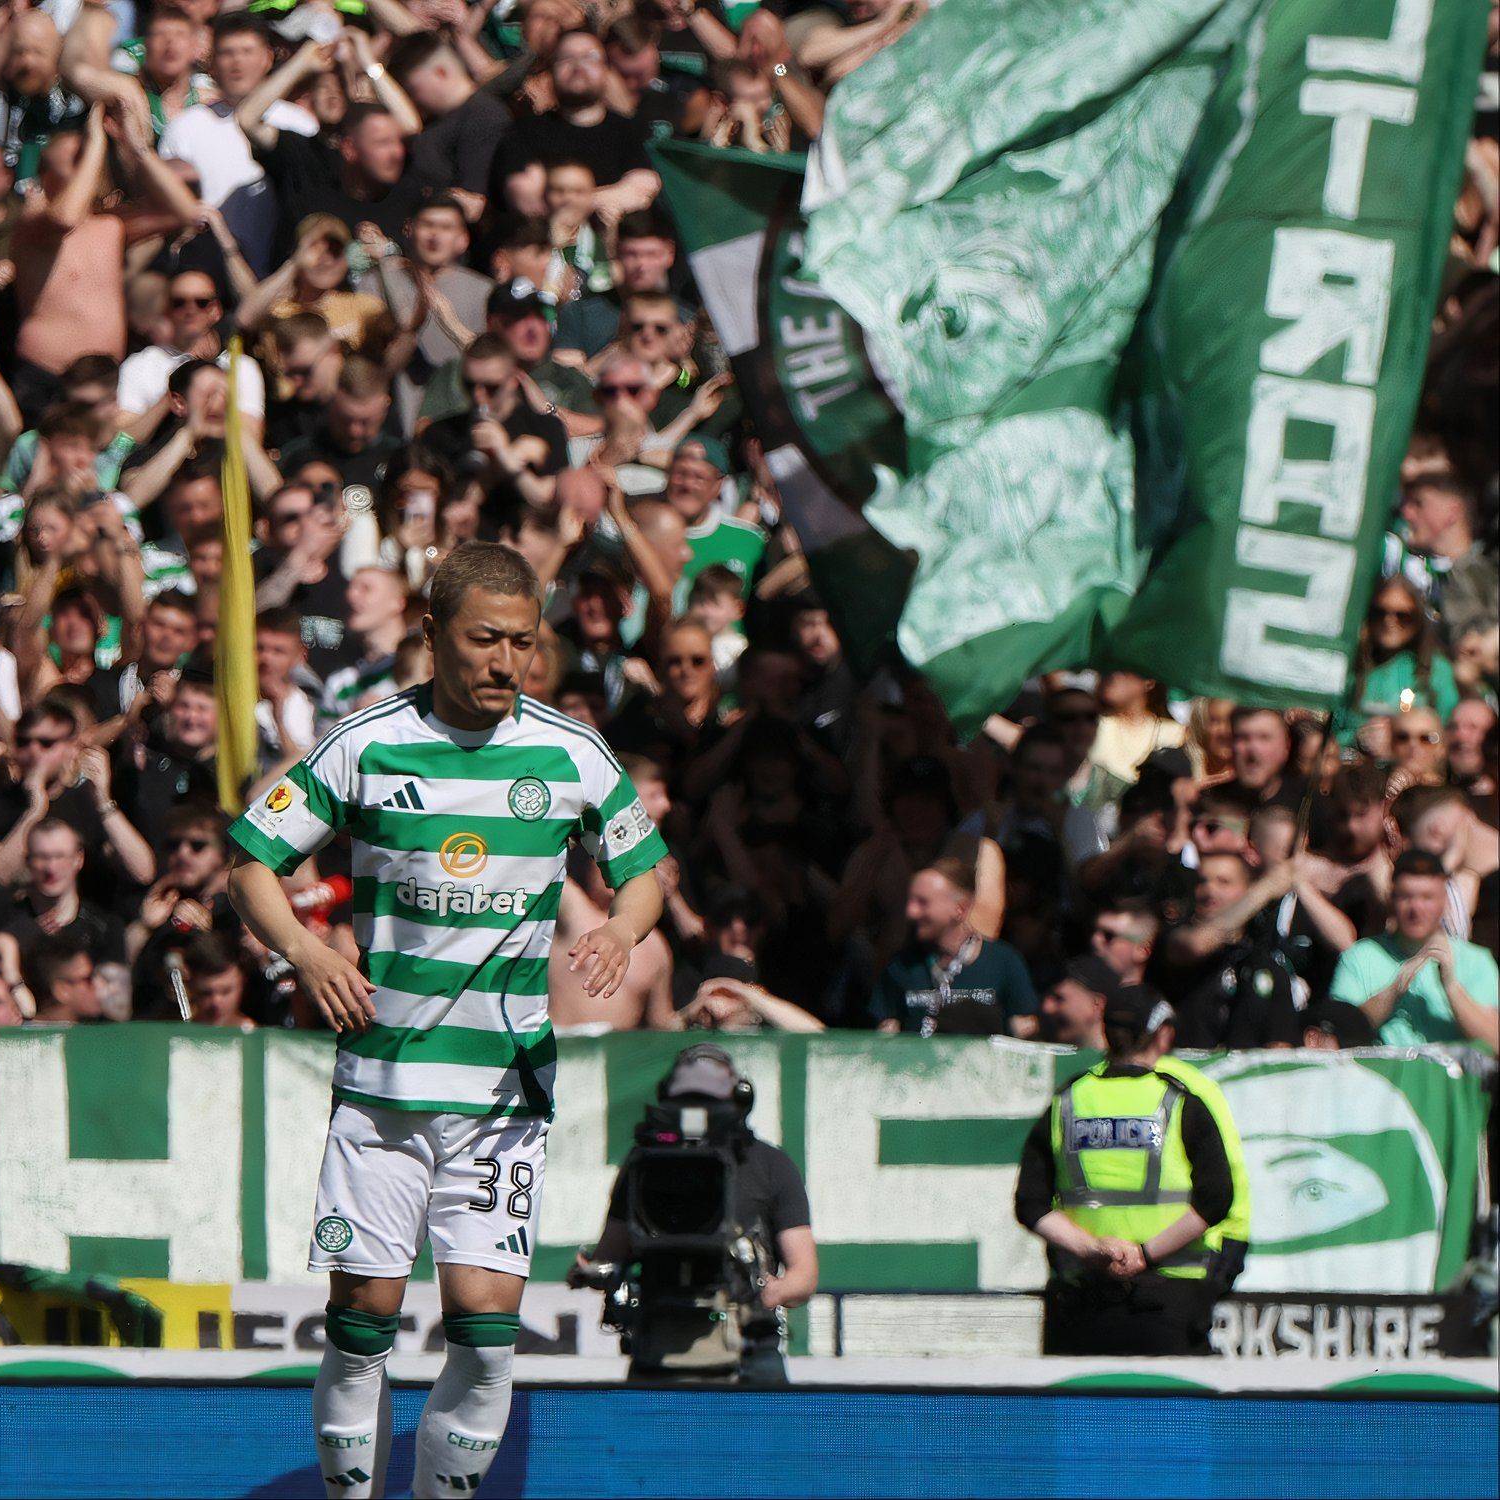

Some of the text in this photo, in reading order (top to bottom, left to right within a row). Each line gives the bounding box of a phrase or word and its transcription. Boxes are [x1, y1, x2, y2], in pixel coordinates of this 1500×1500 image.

[779, 311, 859, 422] THE
[396, 877, 528, 917] dafabet
[468, 1157, 534, 1220] 38
